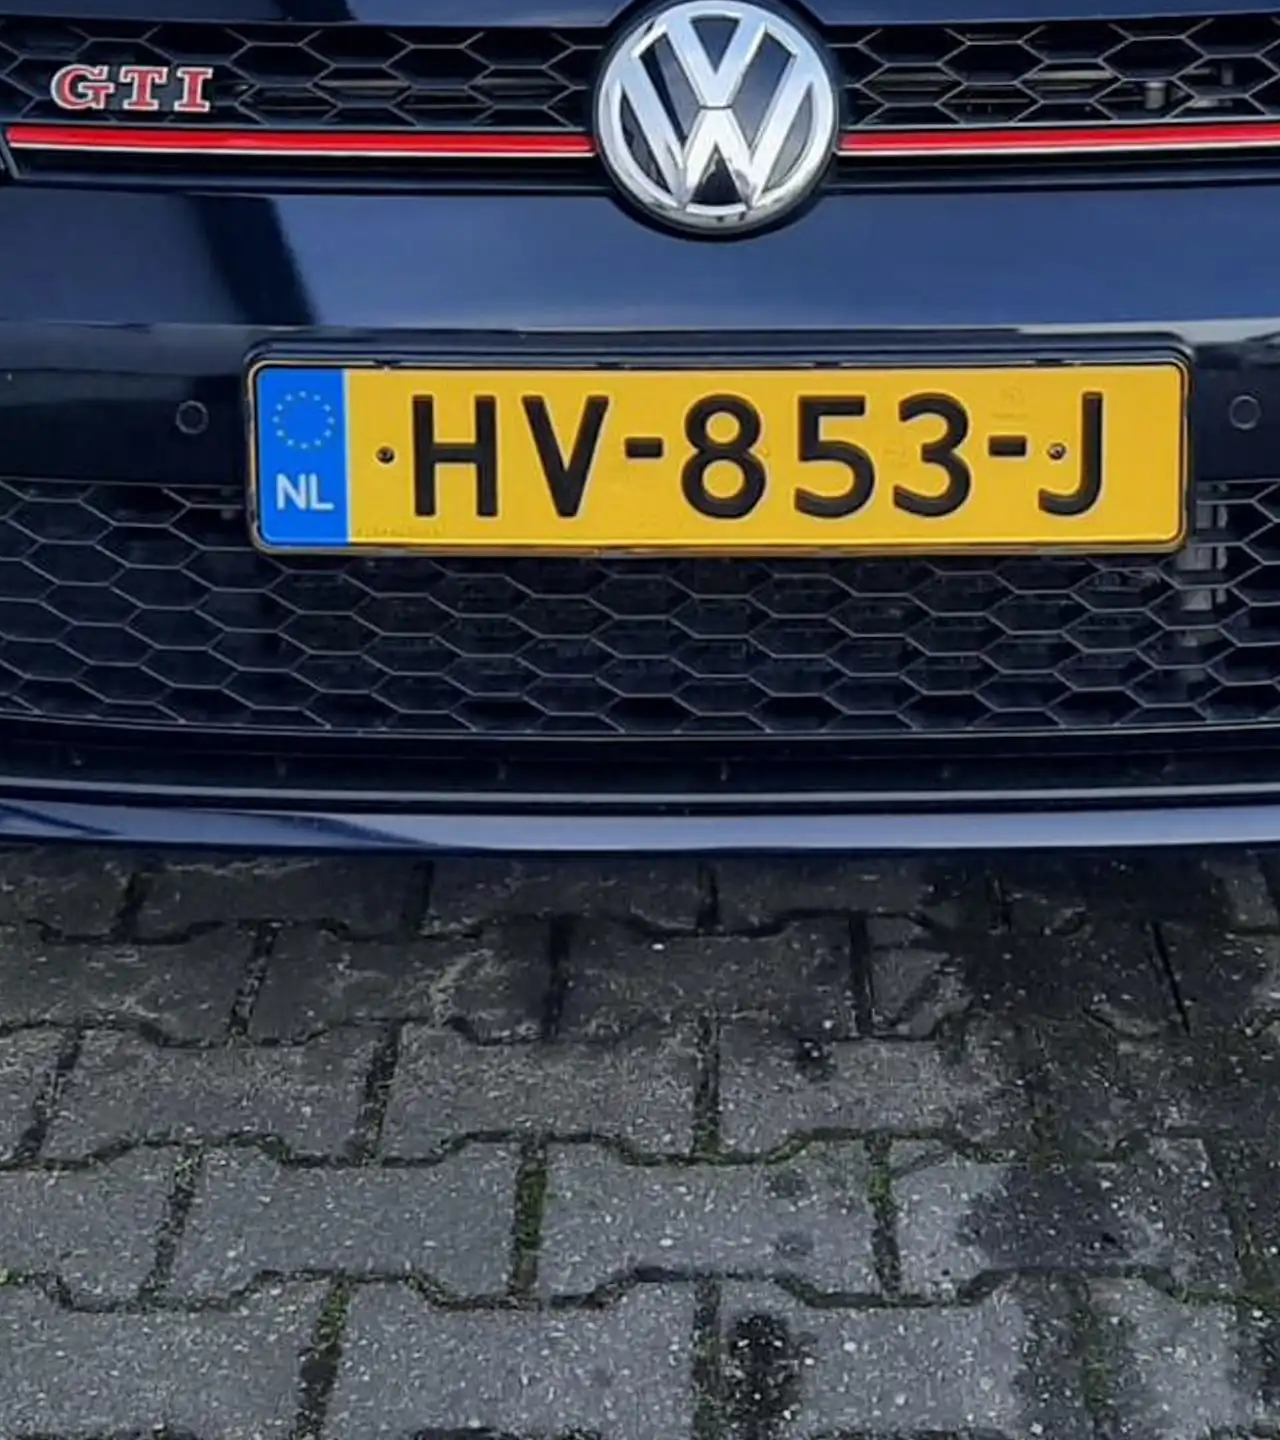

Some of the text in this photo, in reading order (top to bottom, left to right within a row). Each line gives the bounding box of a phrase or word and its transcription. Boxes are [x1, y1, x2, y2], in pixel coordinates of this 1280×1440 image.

[50, 64, 213, 112] GTI
[602, 0, 830, 222] VW
[275, 472, 335, 511] NL
[411, 391, 1104, 519] HV-853-J
